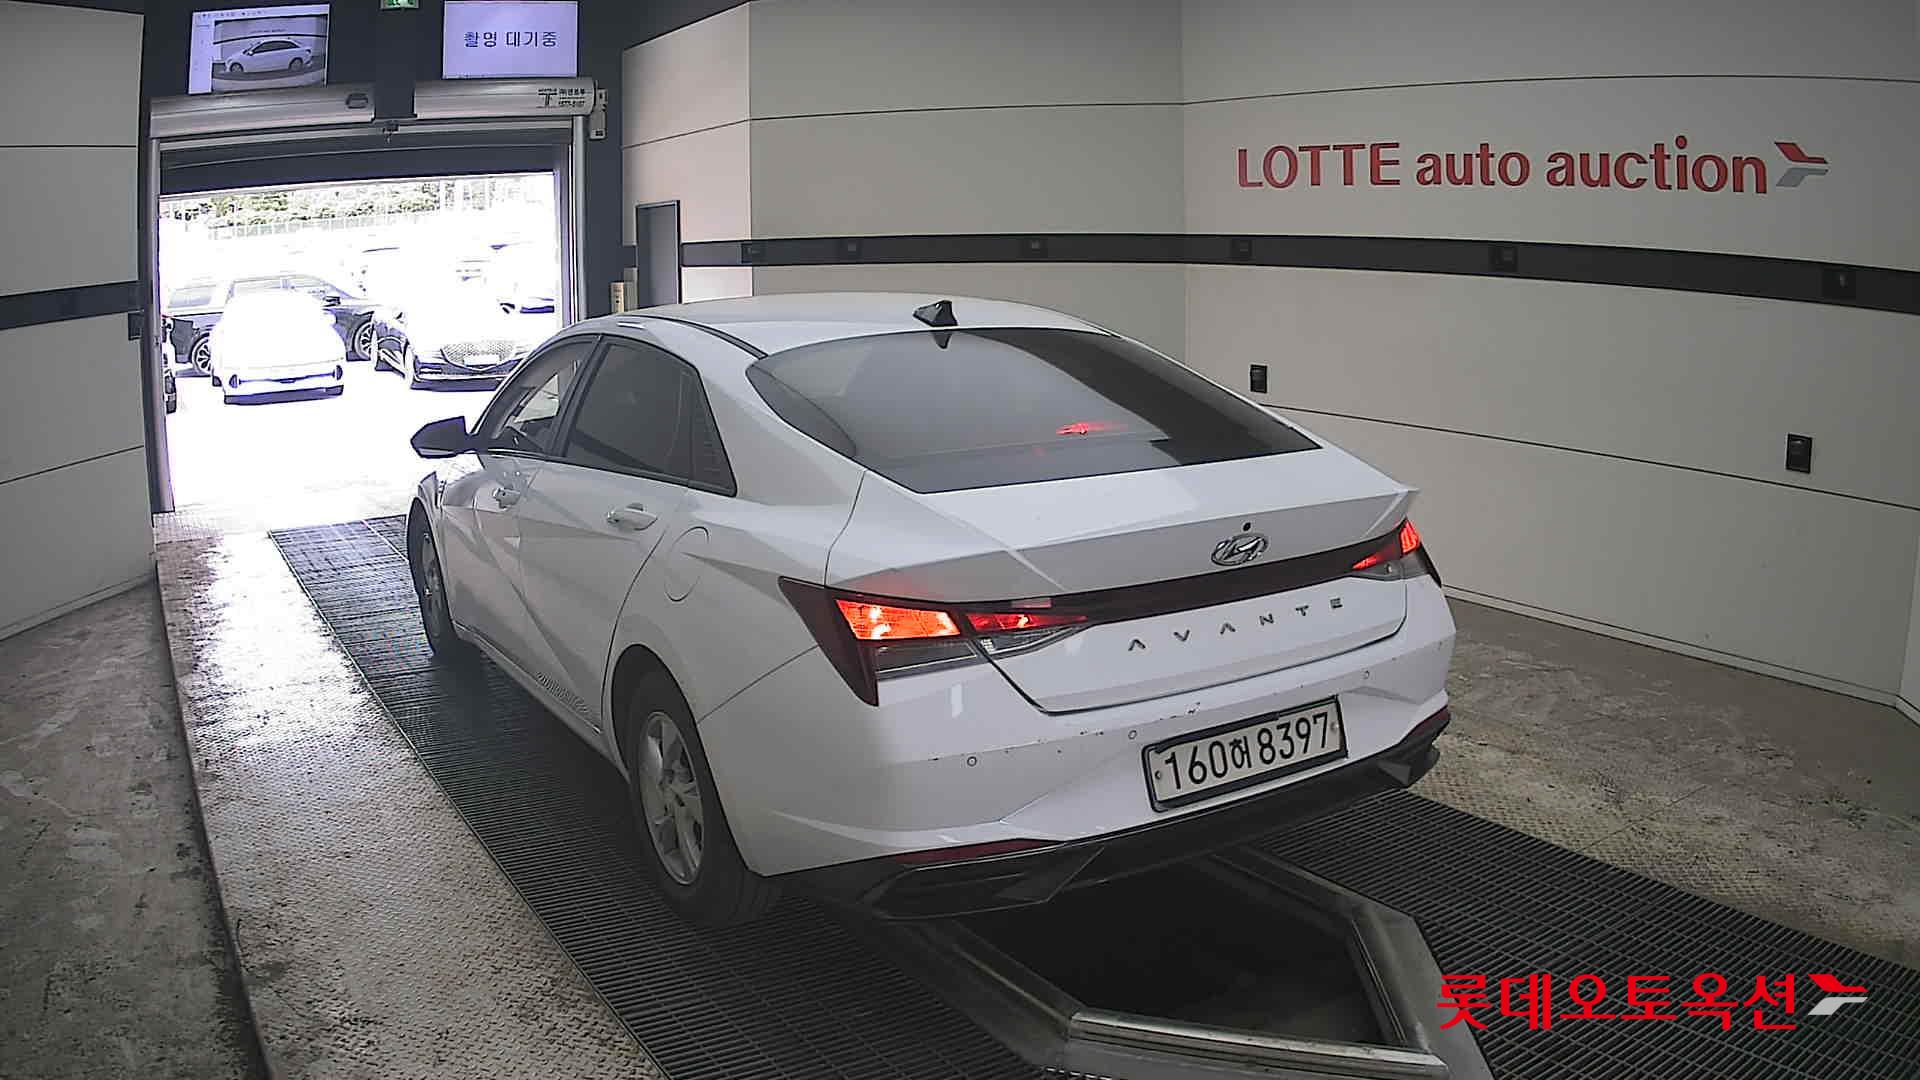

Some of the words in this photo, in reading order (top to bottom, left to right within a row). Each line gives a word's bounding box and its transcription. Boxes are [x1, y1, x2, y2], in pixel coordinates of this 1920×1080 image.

[507, 31, 556, 48] 대기중
[1237, 143, 1400, 189] LOTTE
[1416, 142, 1531, 187] auto
[1545, 135, 1768, 195] auction
[1128, 597, 1343, 652] AVANTE
